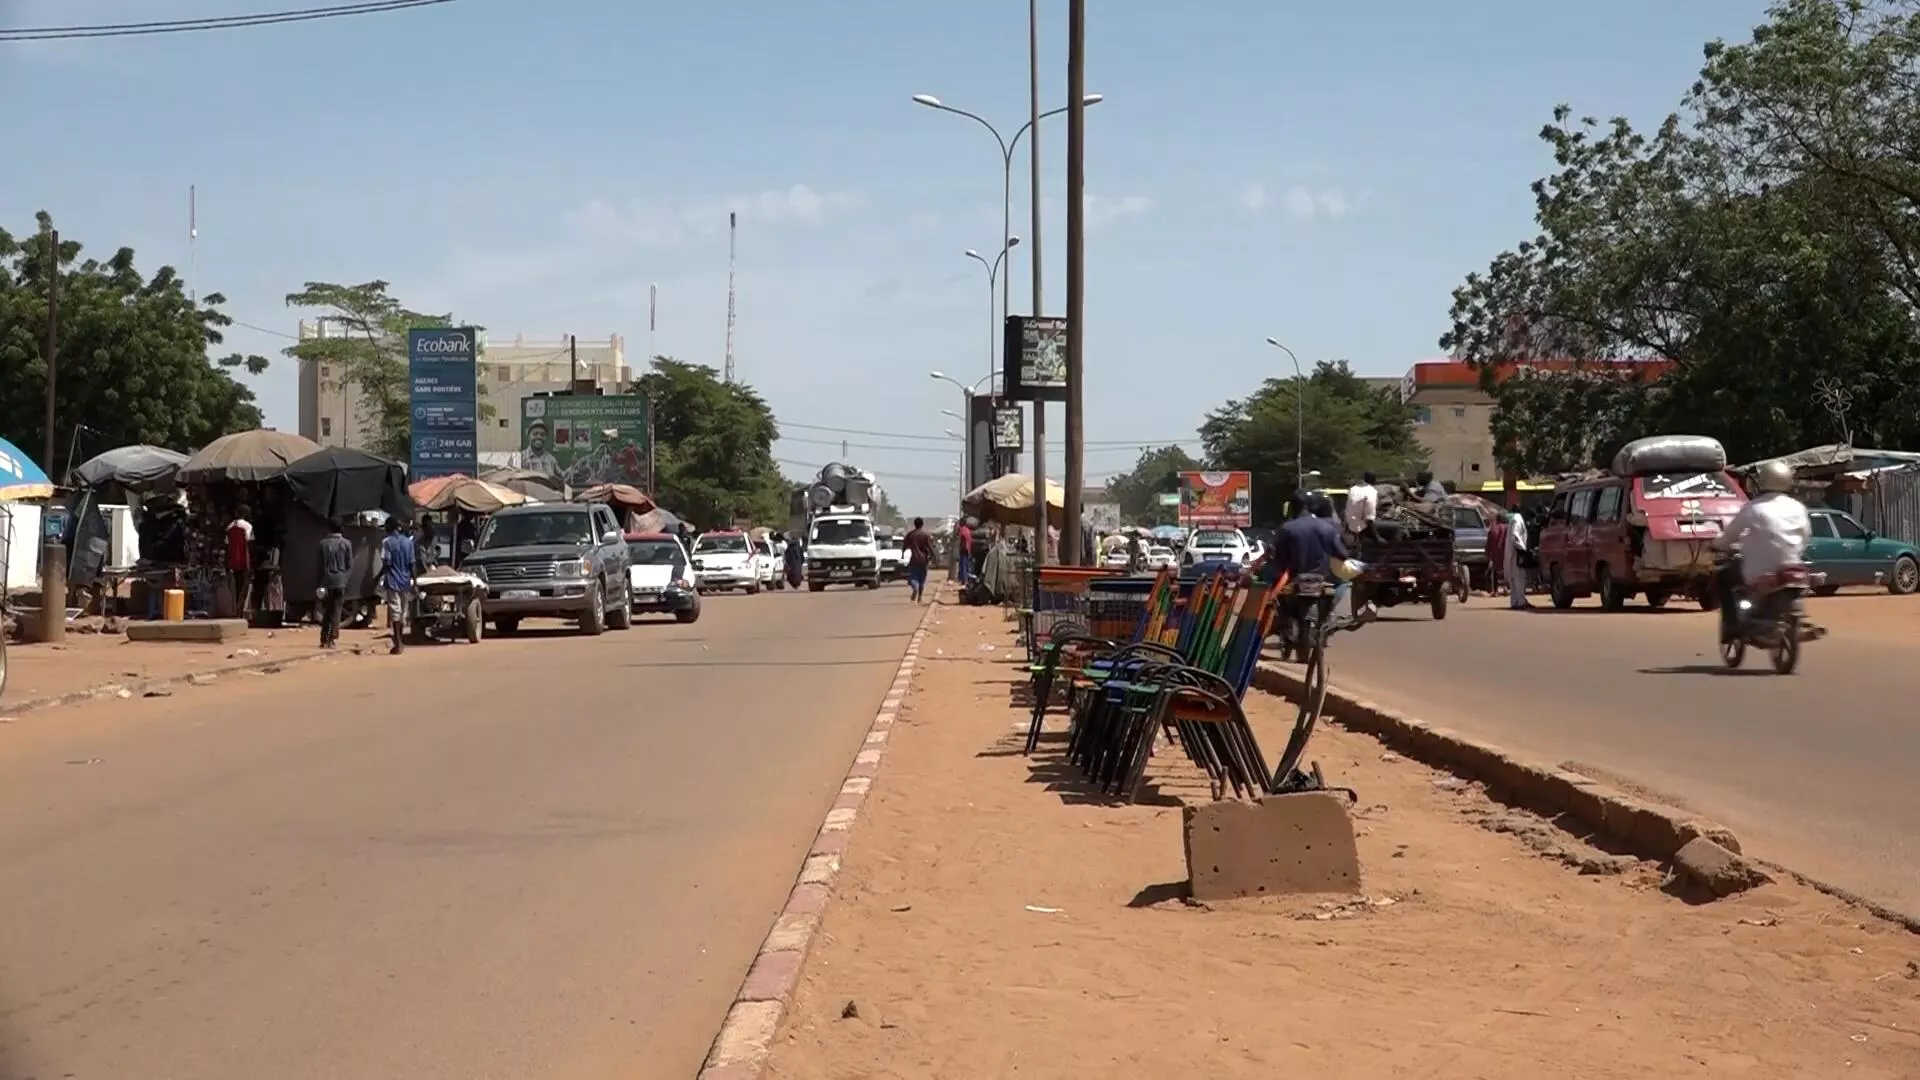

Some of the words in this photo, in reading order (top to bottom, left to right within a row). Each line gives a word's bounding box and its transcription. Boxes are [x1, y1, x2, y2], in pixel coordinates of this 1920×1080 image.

[416, 334, 470, 352] Ecobank
[605, 408, 641, 416] MEILLEURS
[439, 439, 455, 448] 24H
[456, 439, 472, 448] GAB
